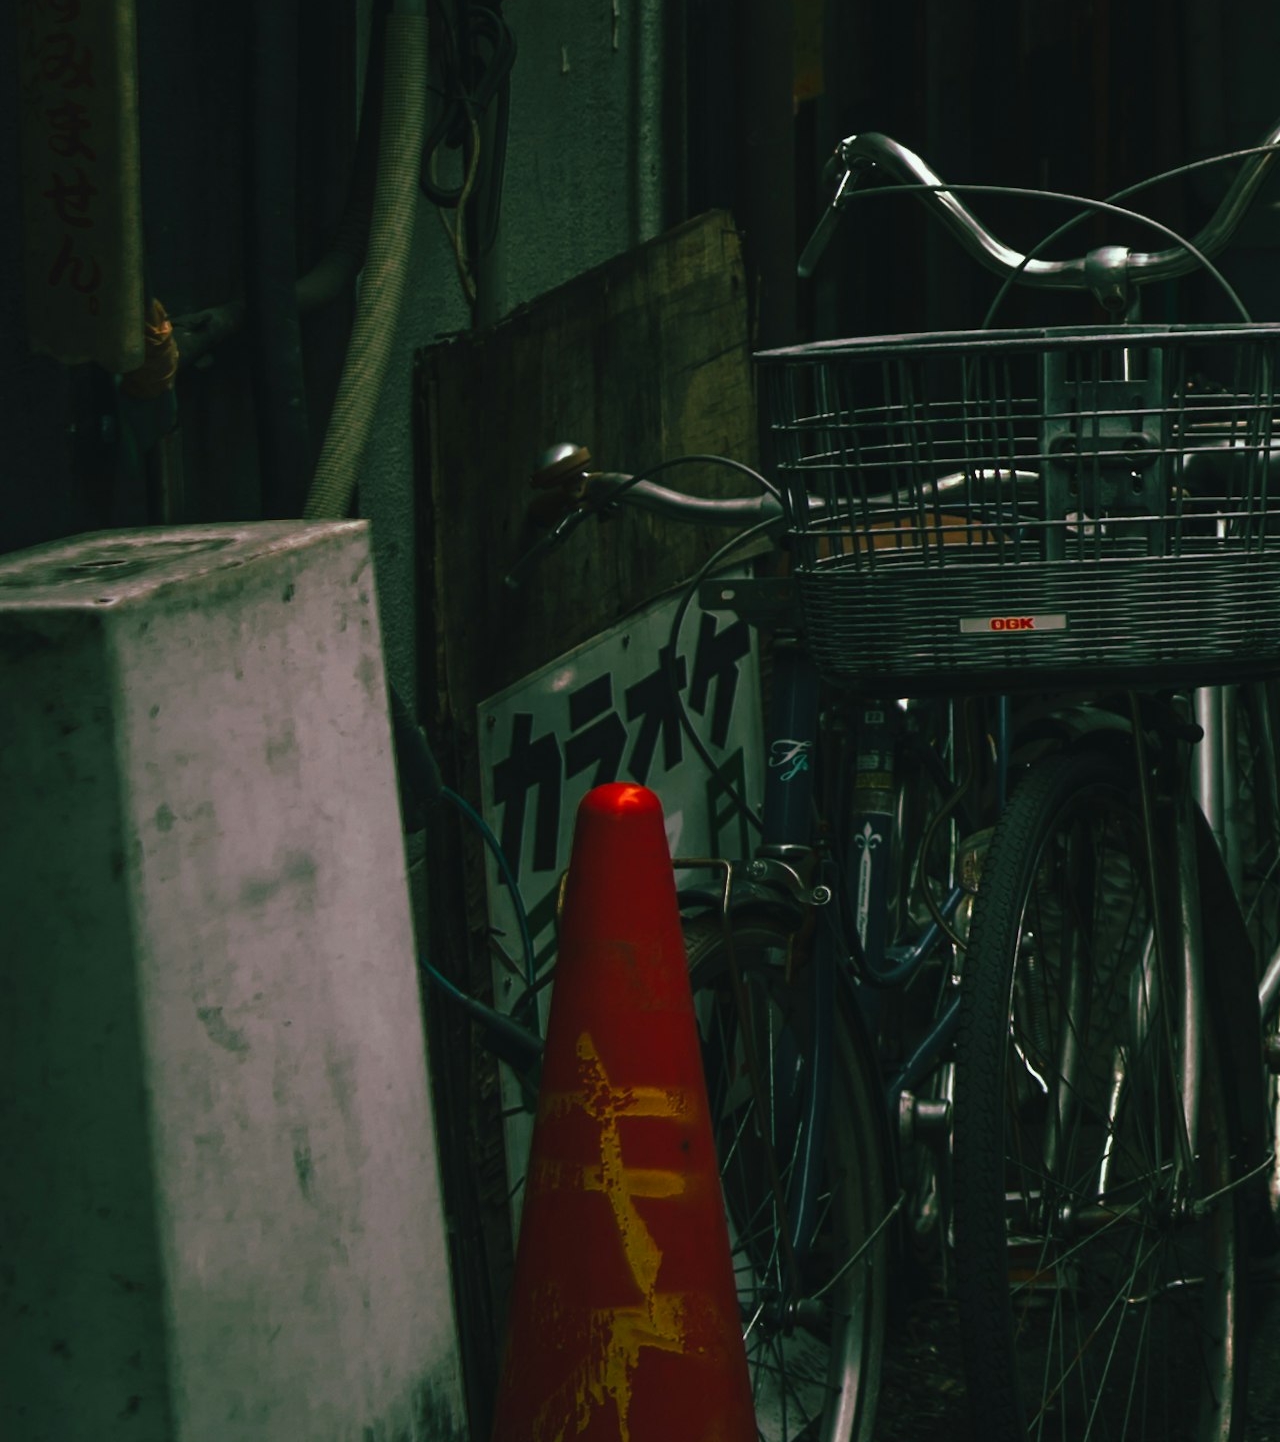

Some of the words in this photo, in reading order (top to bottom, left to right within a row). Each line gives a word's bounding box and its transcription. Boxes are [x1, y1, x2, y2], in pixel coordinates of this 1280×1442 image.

[991, 617, 1035, 631] OGK
[492, 612, 750, 886] カラオケ
